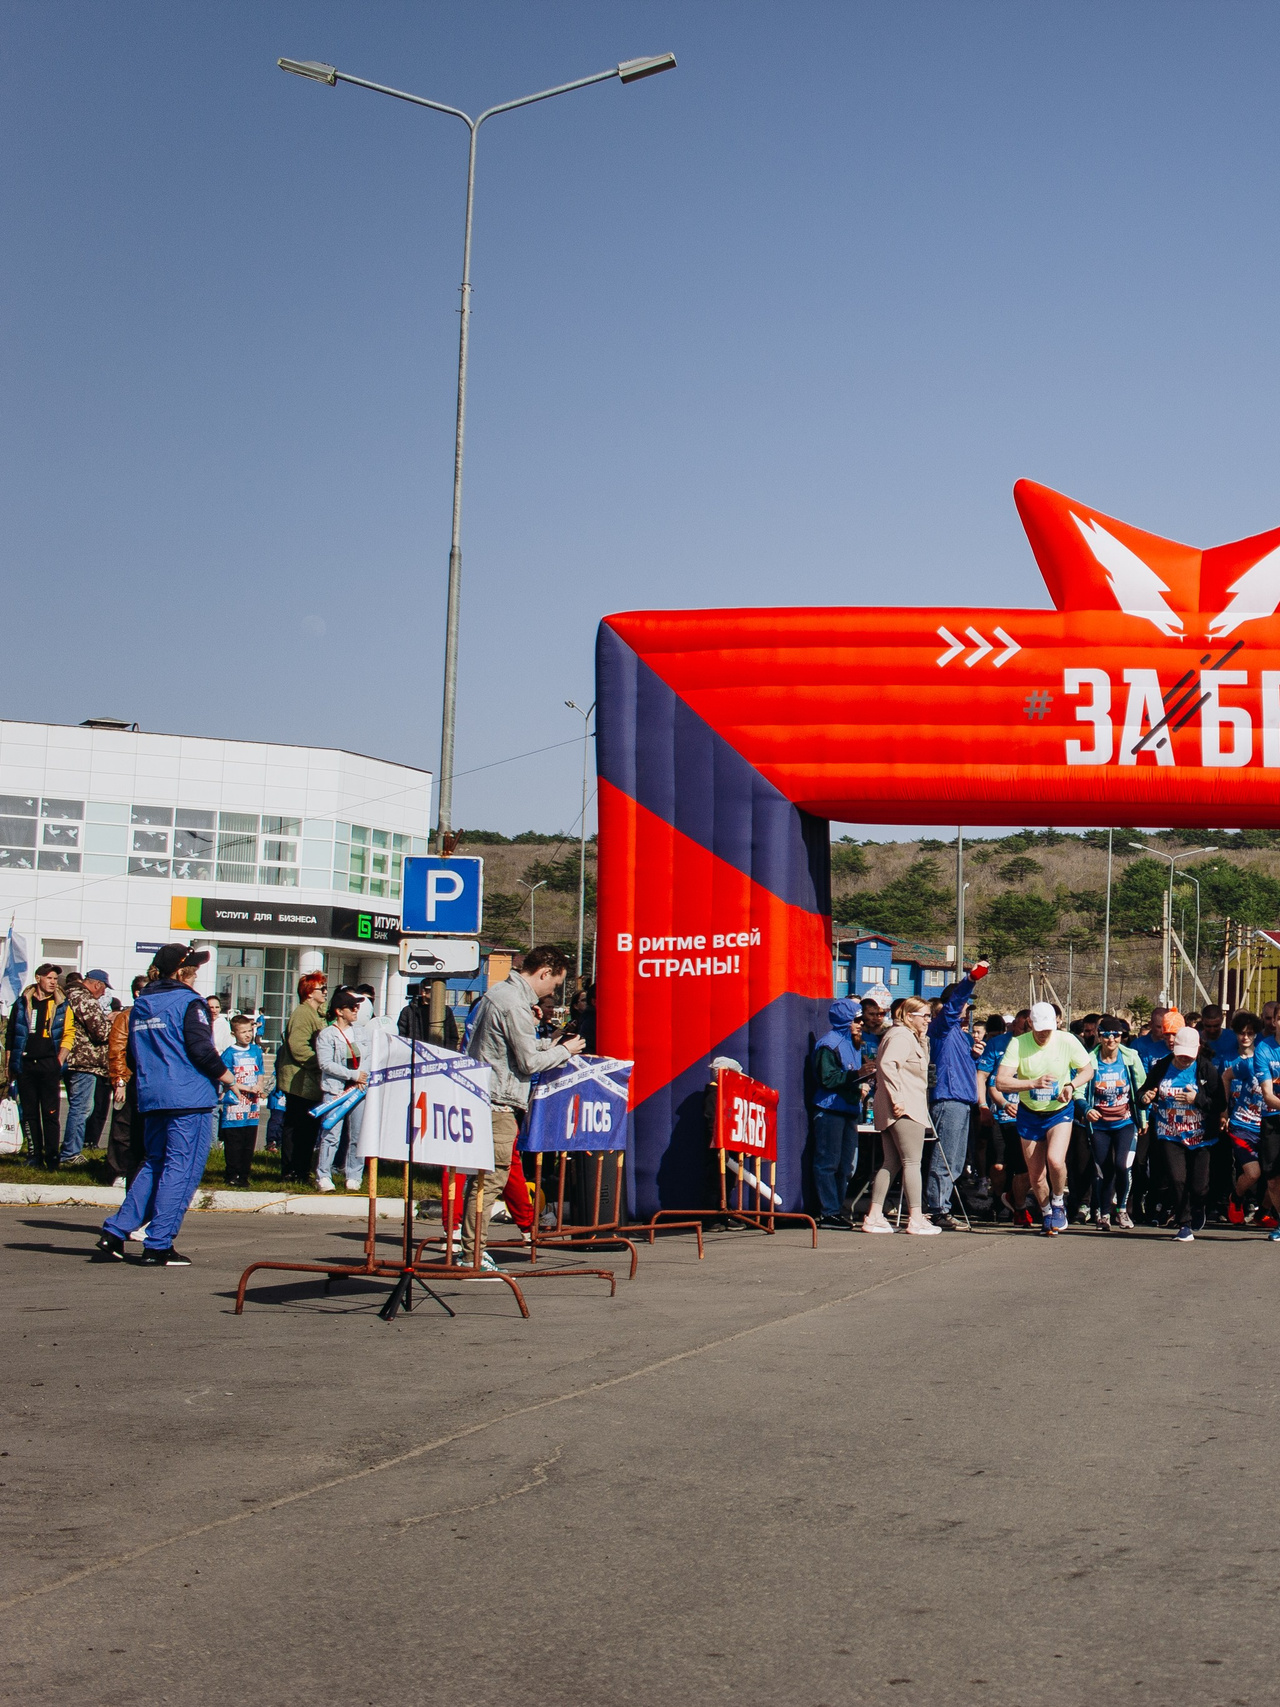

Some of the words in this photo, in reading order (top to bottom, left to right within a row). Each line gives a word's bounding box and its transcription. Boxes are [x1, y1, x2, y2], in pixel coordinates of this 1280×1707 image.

[426, 870, 464, 921] P
[216, 910, 249, 920] УСЛУГИ
[253, 912, 272, 921] ДЛЯ
[278, 914, 317, 924] БИЗНЕСА
[374, 915, 400, 931] ИТУРУ
[374, 930, 388, 940] БАНК
[617, 933, 633, 951] В
[638, 935, 706, 954] ритме
[712, 928, 761, 948] всей
[638, 955, 740, 977] СТРАНЫ!
[433, 1103, 474, 1143] ПСБ
[582, 1101, 612, 1133] ПСБ
